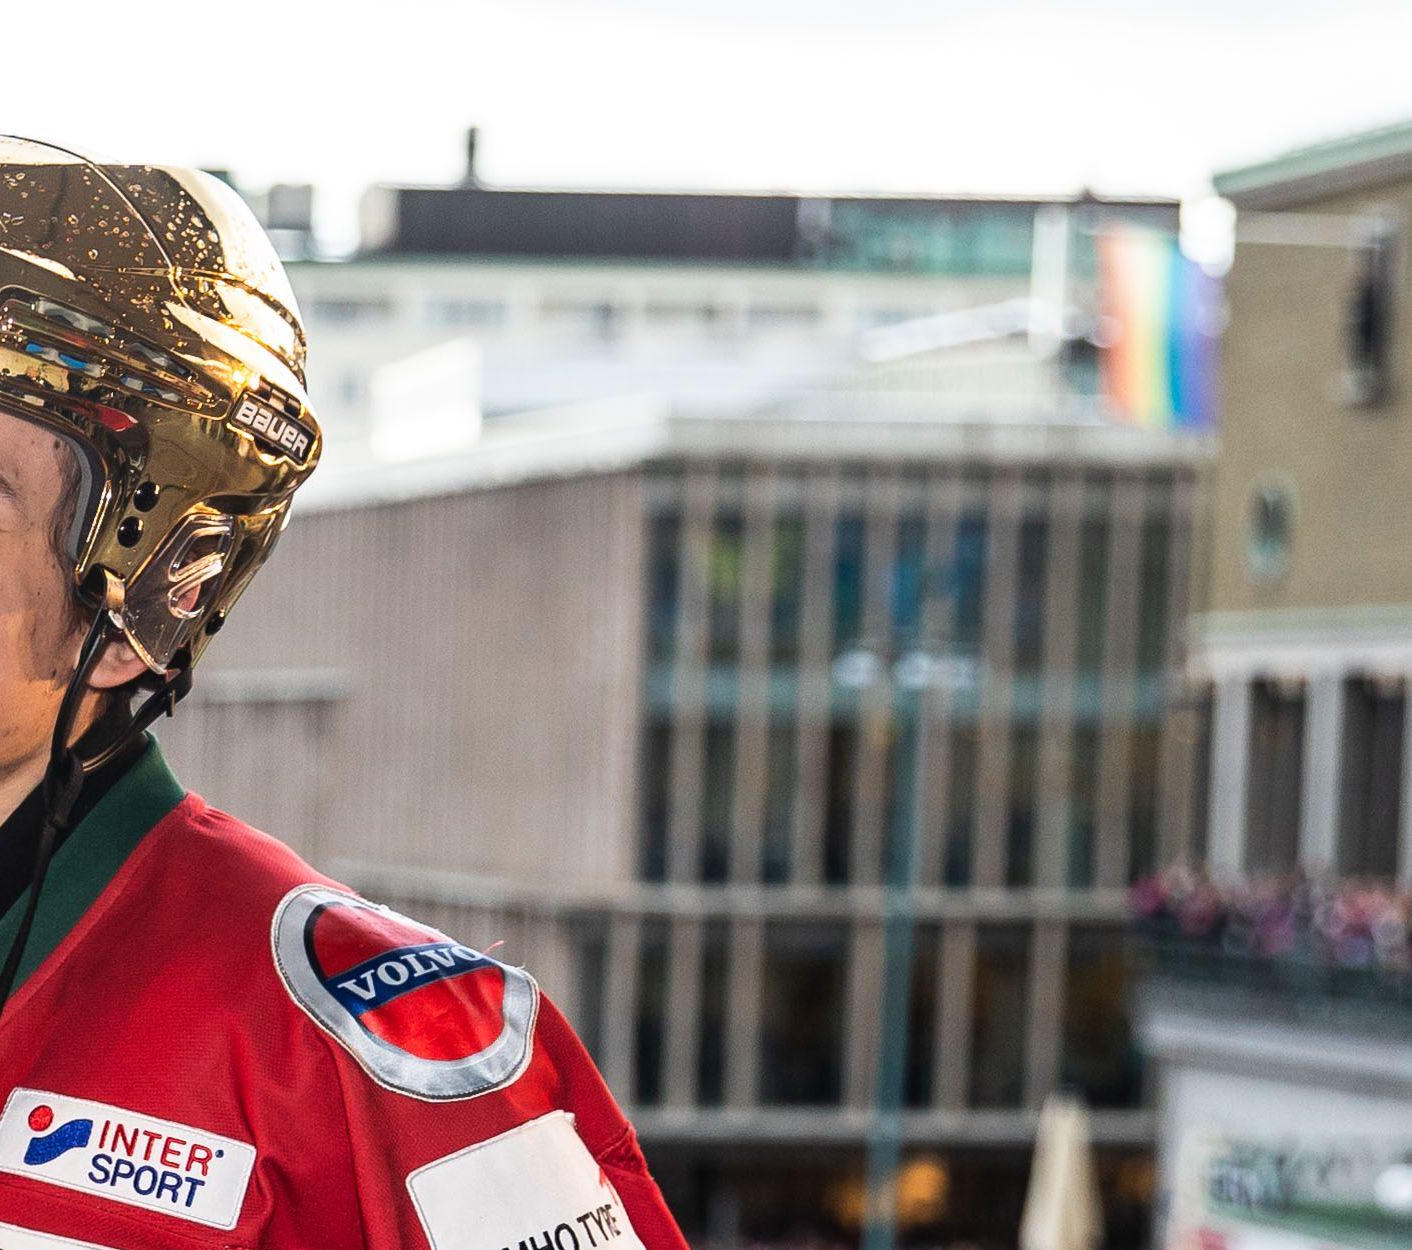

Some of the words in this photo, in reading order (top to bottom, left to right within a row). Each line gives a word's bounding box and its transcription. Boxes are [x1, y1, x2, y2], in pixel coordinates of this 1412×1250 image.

[234, 398, 310, 459] BAUER
[338, 945, 483, 1001] VOLVO
[98, 1119, 215, 1176] INTER
[88, 1155, 206, 1208] SPORT
